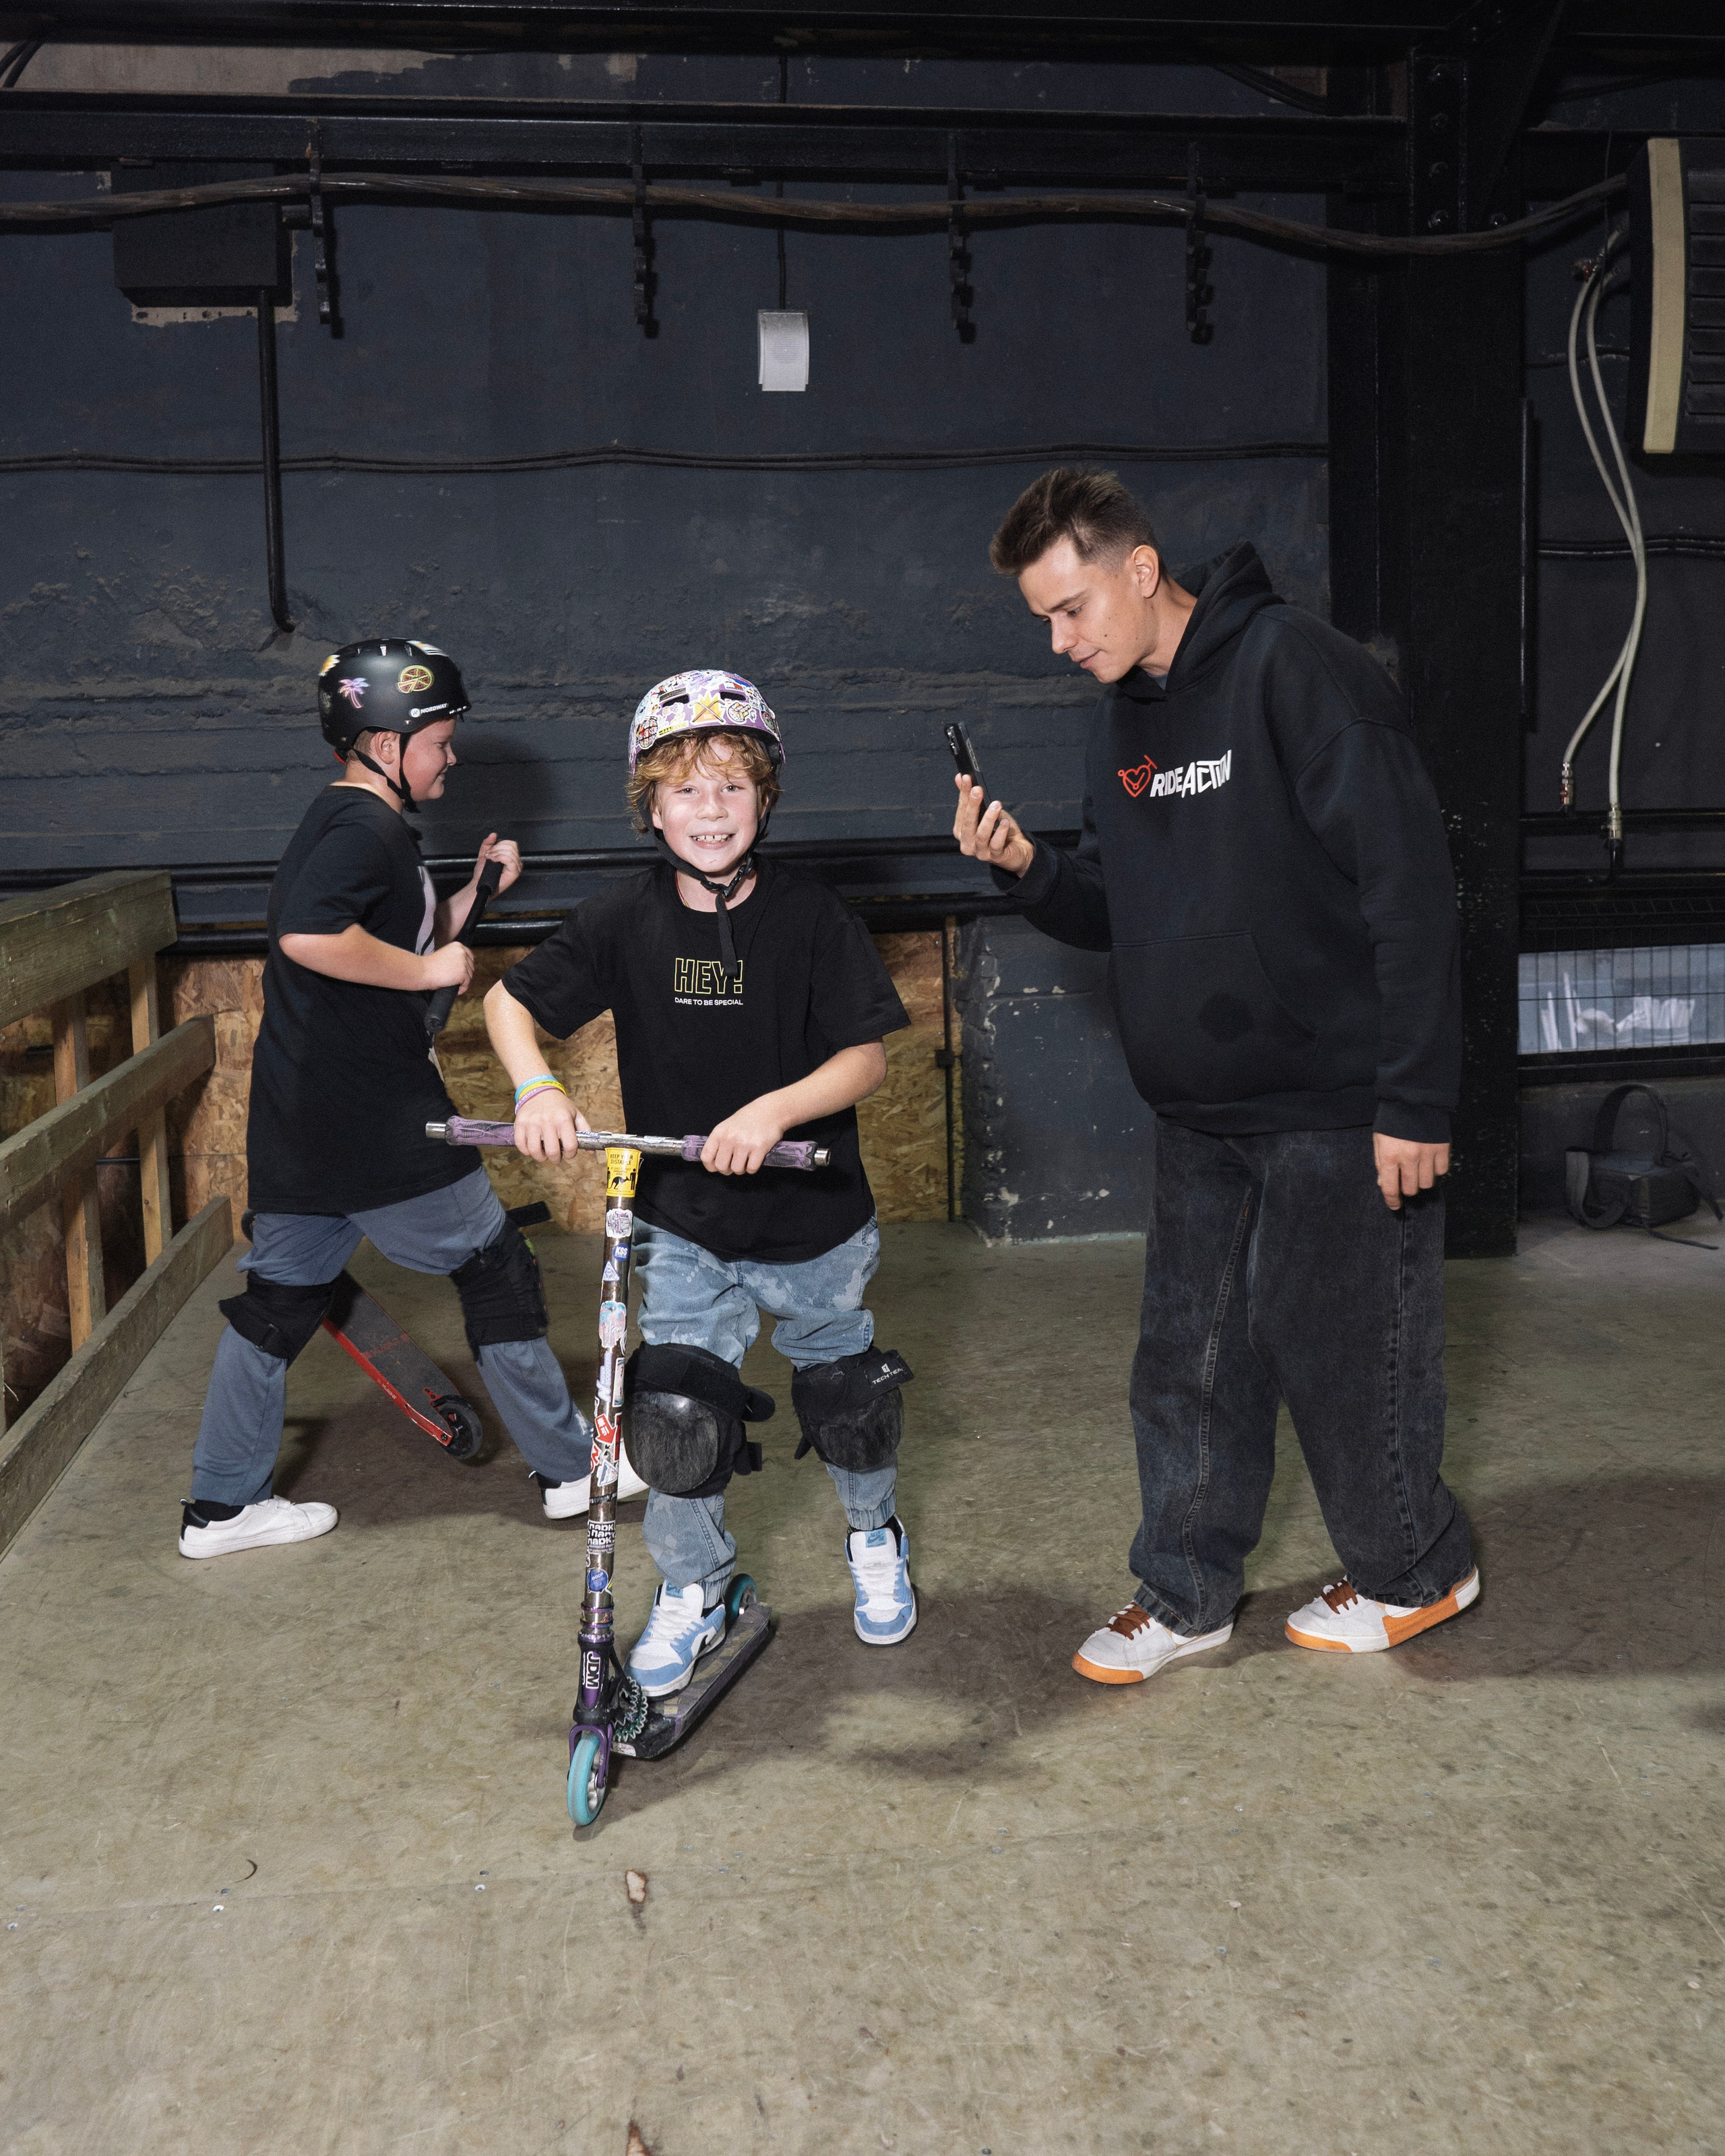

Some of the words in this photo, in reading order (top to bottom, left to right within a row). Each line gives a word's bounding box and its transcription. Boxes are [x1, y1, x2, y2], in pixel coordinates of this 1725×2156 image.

[420, 703, 447, 714] NORDWAY
[675, 957, 743, 994] HEY!
[675, 997, 692, 1005] DARE
[615, 1246, 628, 1257] KSS
[872, 1373, 889, 1385] TECH
[586, 1651, 601, 1689] JDM
